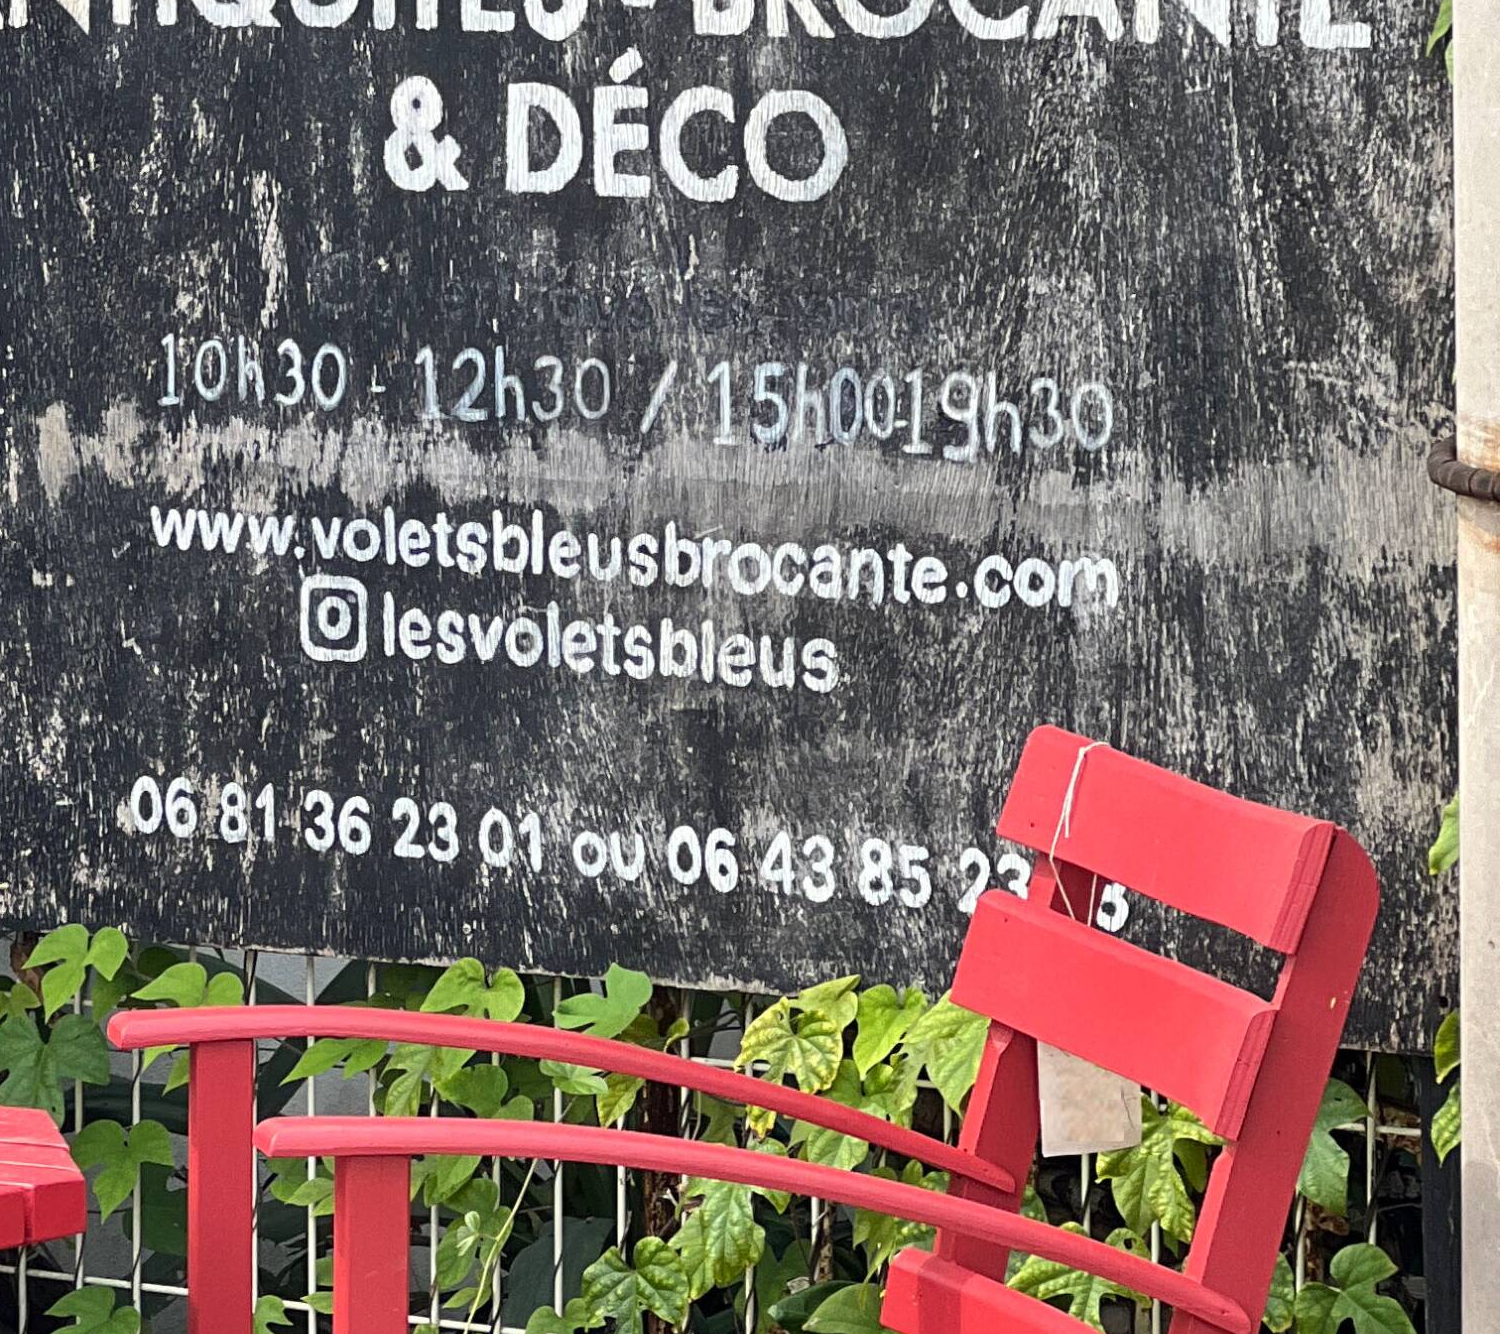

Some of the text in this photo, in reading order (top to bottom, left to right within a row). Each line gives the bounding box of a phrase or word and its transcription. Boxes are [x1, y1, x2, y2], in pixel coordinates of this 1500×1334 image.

[384, 47, 849, 203] & DÉCO
[157, 333, 347, 411] 10h30
[414, 344, 611, 423] 12h30
[639, 360, 677, 434] /
[150, 505, 1118, 609] www.voletsbleusbrocante.com
[383, 591, 839, 694] lesvoletsbleus
[131, 775, 198, 838] 06
[219, 781, 275, 843] 81
[304, 789, 372, 856] 36
[391, 797, 460, 863] 23
[478, 806, 543, 873] 01
[667, 825, 738, 894] 06
[761, 830, 836, 903] 43
[858, 837, 933, 909] 85
